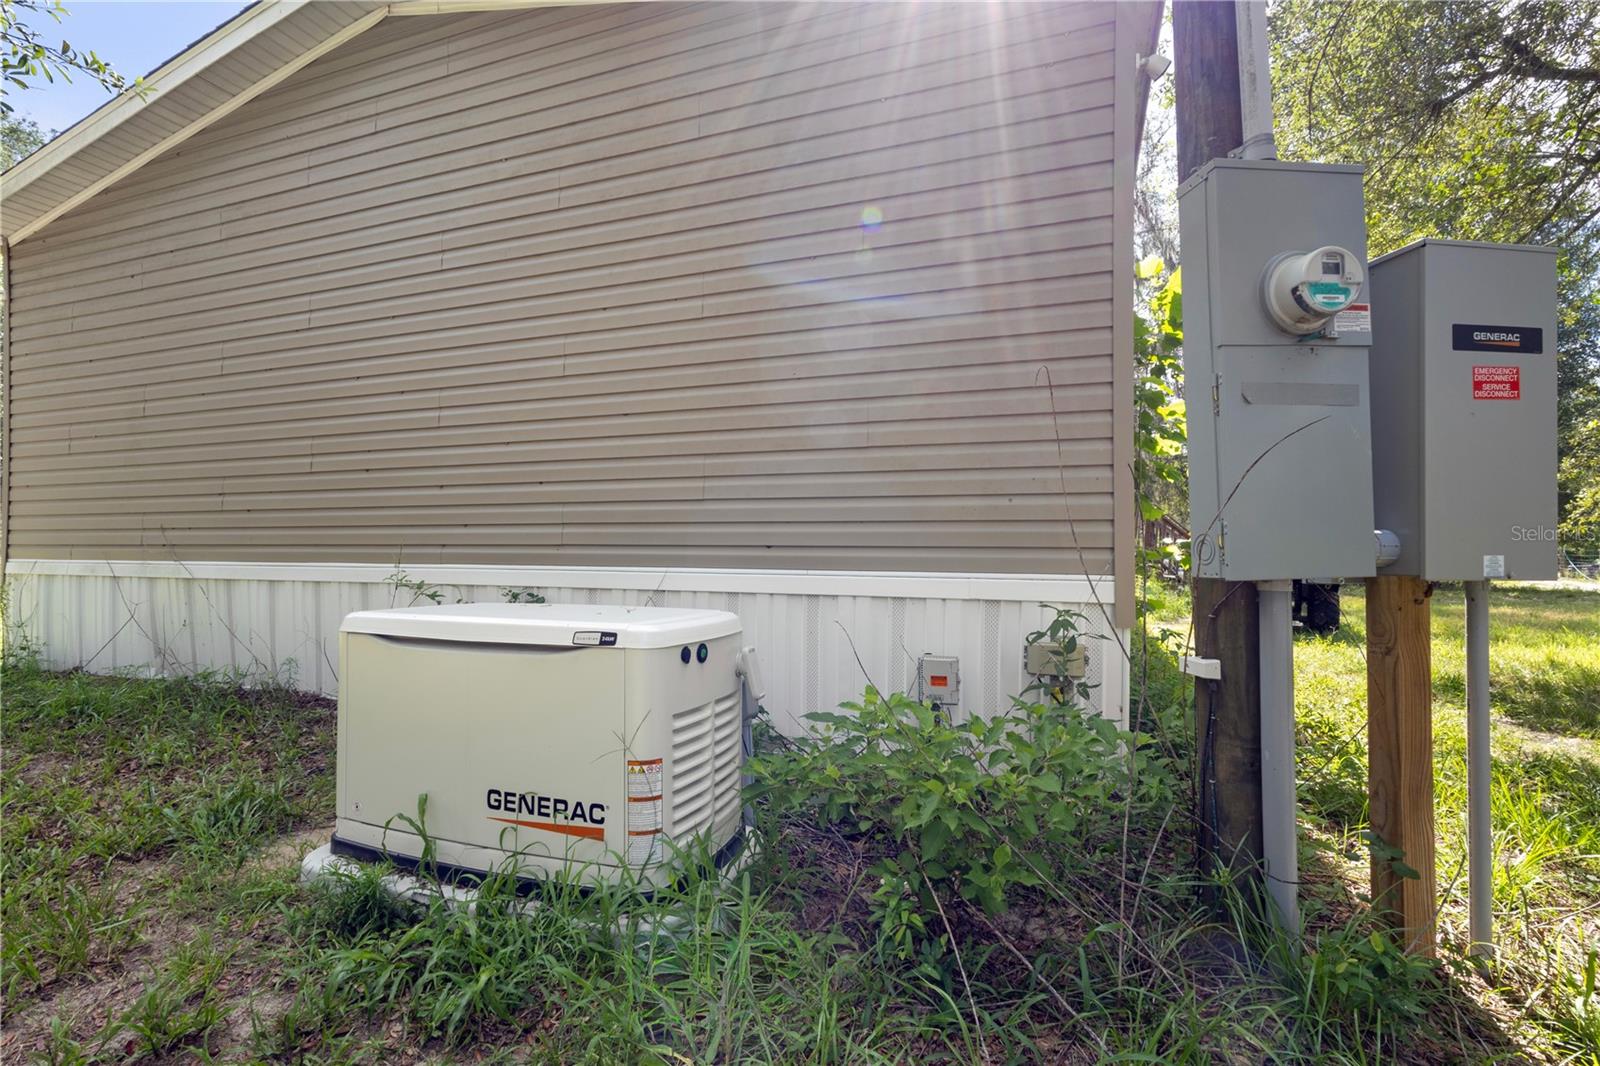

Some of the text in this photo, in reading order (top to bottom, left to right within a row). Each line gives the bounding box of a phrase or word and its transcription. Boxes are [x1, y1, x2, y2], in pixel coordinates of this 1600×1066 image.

[1473, 332, 1520, 342] GENERAC
[1474, 367, 1517, 375] EMERGENCY
[1474, 374, 1518, 382] DISCONNECT
[1482, 383, 1511, 391] SERVICE
[1474, 390, 1519, 398] DISCONNECT
[487, 789, 606, 825] GENERAC
